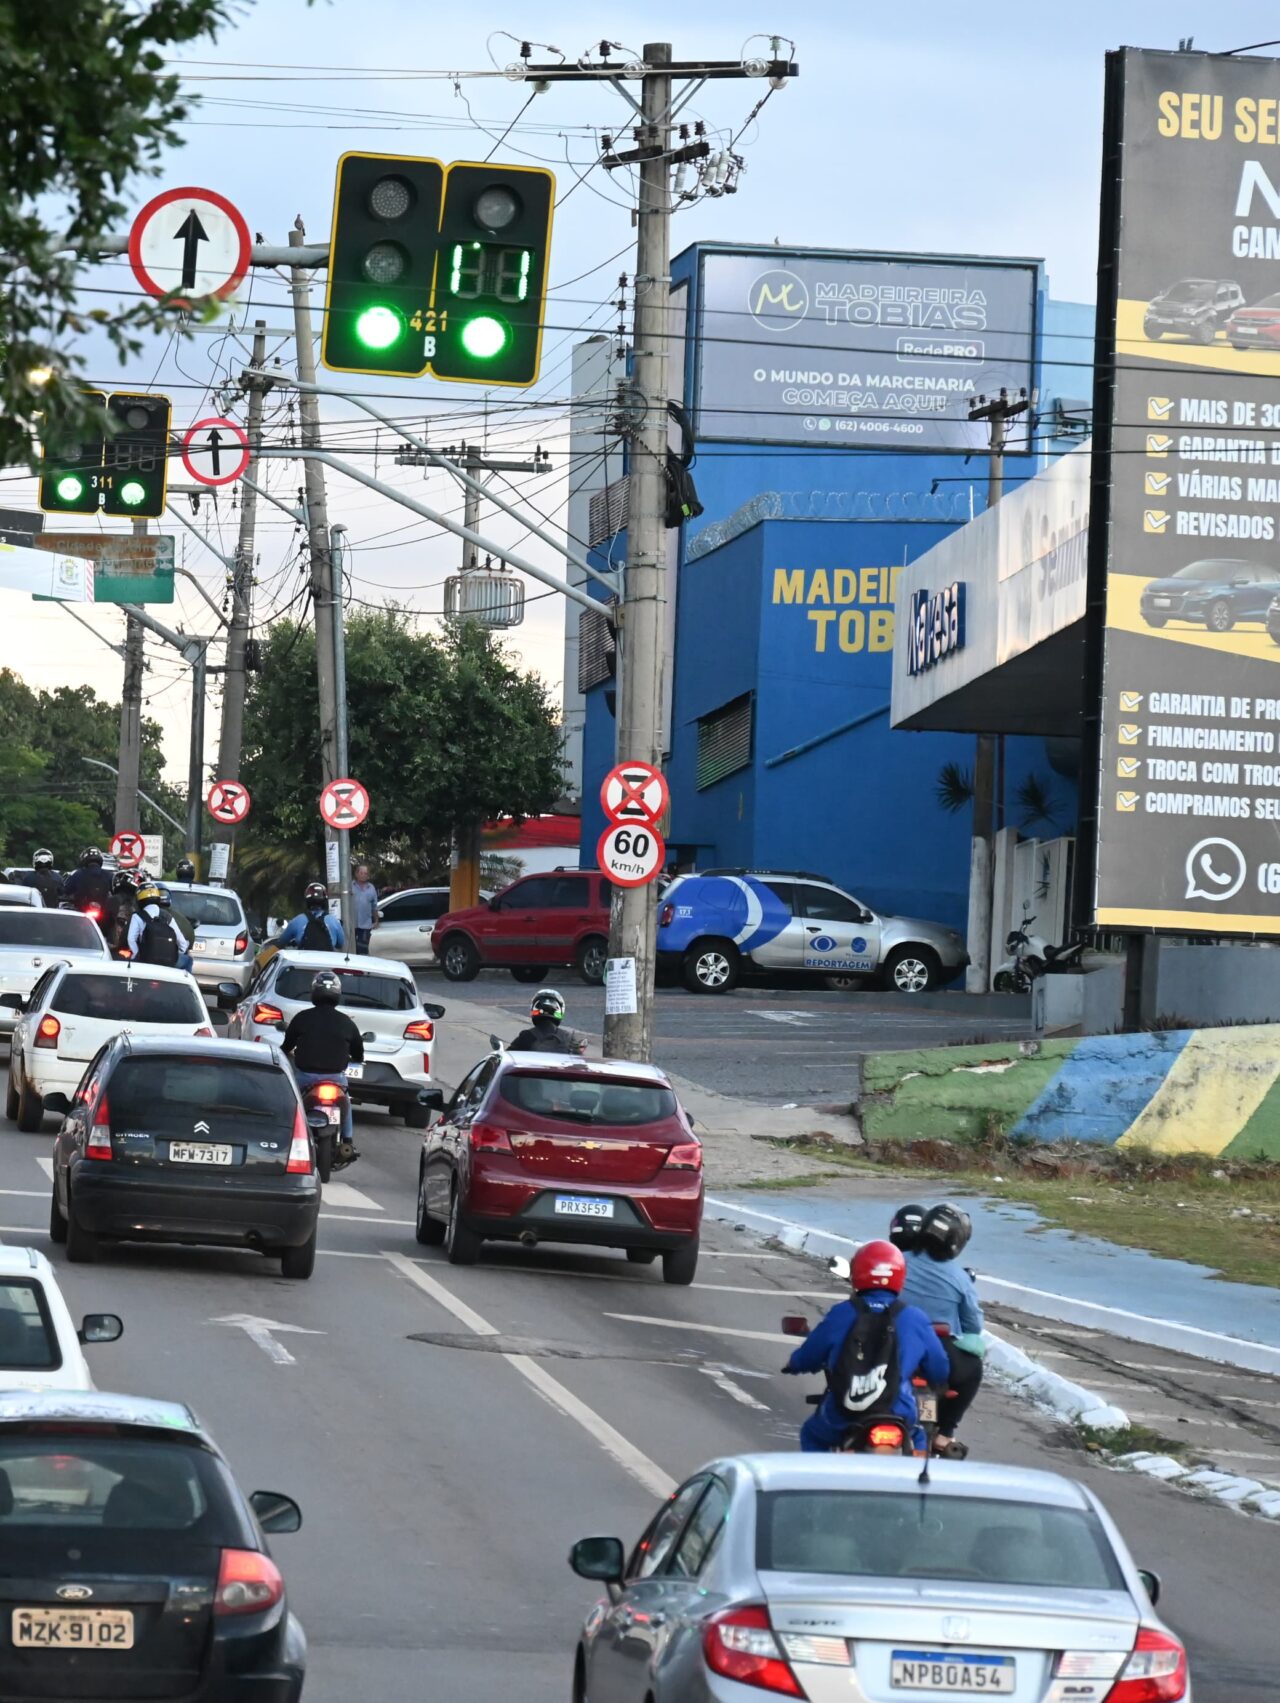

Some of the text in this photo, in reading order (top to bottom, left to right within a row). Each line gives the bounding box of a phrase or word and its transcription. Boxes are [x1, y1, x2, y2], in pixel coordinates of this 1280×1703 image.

[1157, 90, 1280, 145] SEU SE
[816, 282, 987, 305] MADEIREIRA
[409, 309, 448, 332] 421
[816, 298, 987, 332] TOBIAS
[423, 335, 437, 358] B
[753, 368, 975, 392] O MUNDO DA MARCENARIA
[782, 388, 879, 412] COMEÇA
[1180, 398, 1228, 424] MAIS
[1233, 401, 1256, 426] DE
[835, 419, 923, 434] (62) 4006-4600
[1178, 435, 1266, 464] GARANTIA
[91, 475, 113, 489] 311
[1177, 468, 1280, 503] VÁRIAS MA
[98, 492, 106, 505] B
[1176, 510, 1274, 540] REVISADOS
[1148, 692, 1226, 718] GARANTIA
[1230, 697, 1251, 719] DE
[1147, 725, 1275, 753] FINANCIAMENTO
[1146, 758, 1197, 782] TROCA
[1201, 762, 1239, 784] COM
[1145, 791, 1251, 819] COMPRAMOS
[613, 830, 650, 858] 60
[611, 859, 645, 875] km/h
[806, 958, 870, 969] REPORTAGEM
[560, 1200, 608, 1215] PRX3F59
